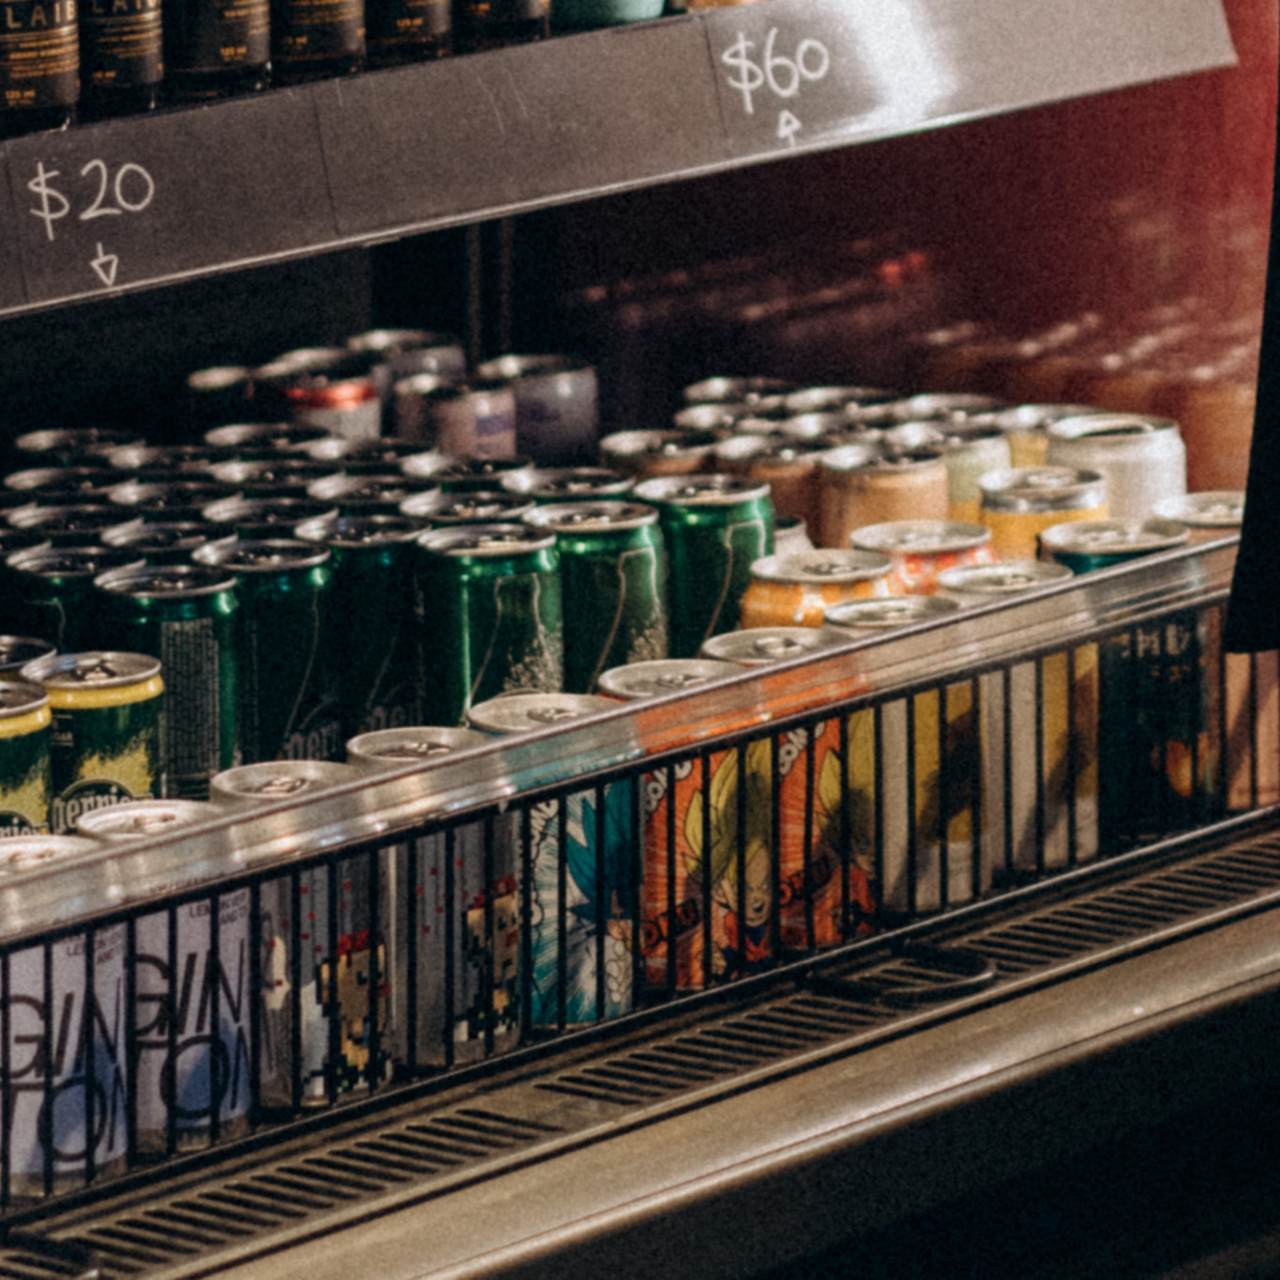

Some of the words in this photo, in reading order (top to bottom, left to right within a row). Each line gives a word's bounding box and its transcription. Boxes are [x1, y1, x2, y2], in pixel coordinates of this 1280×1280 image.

[722, 28, 830, 114] $60
[27, 159, 154, 241] $20
[4, 978, 122, 1080] GIN
[127, 939, 245, 1037] GIN
